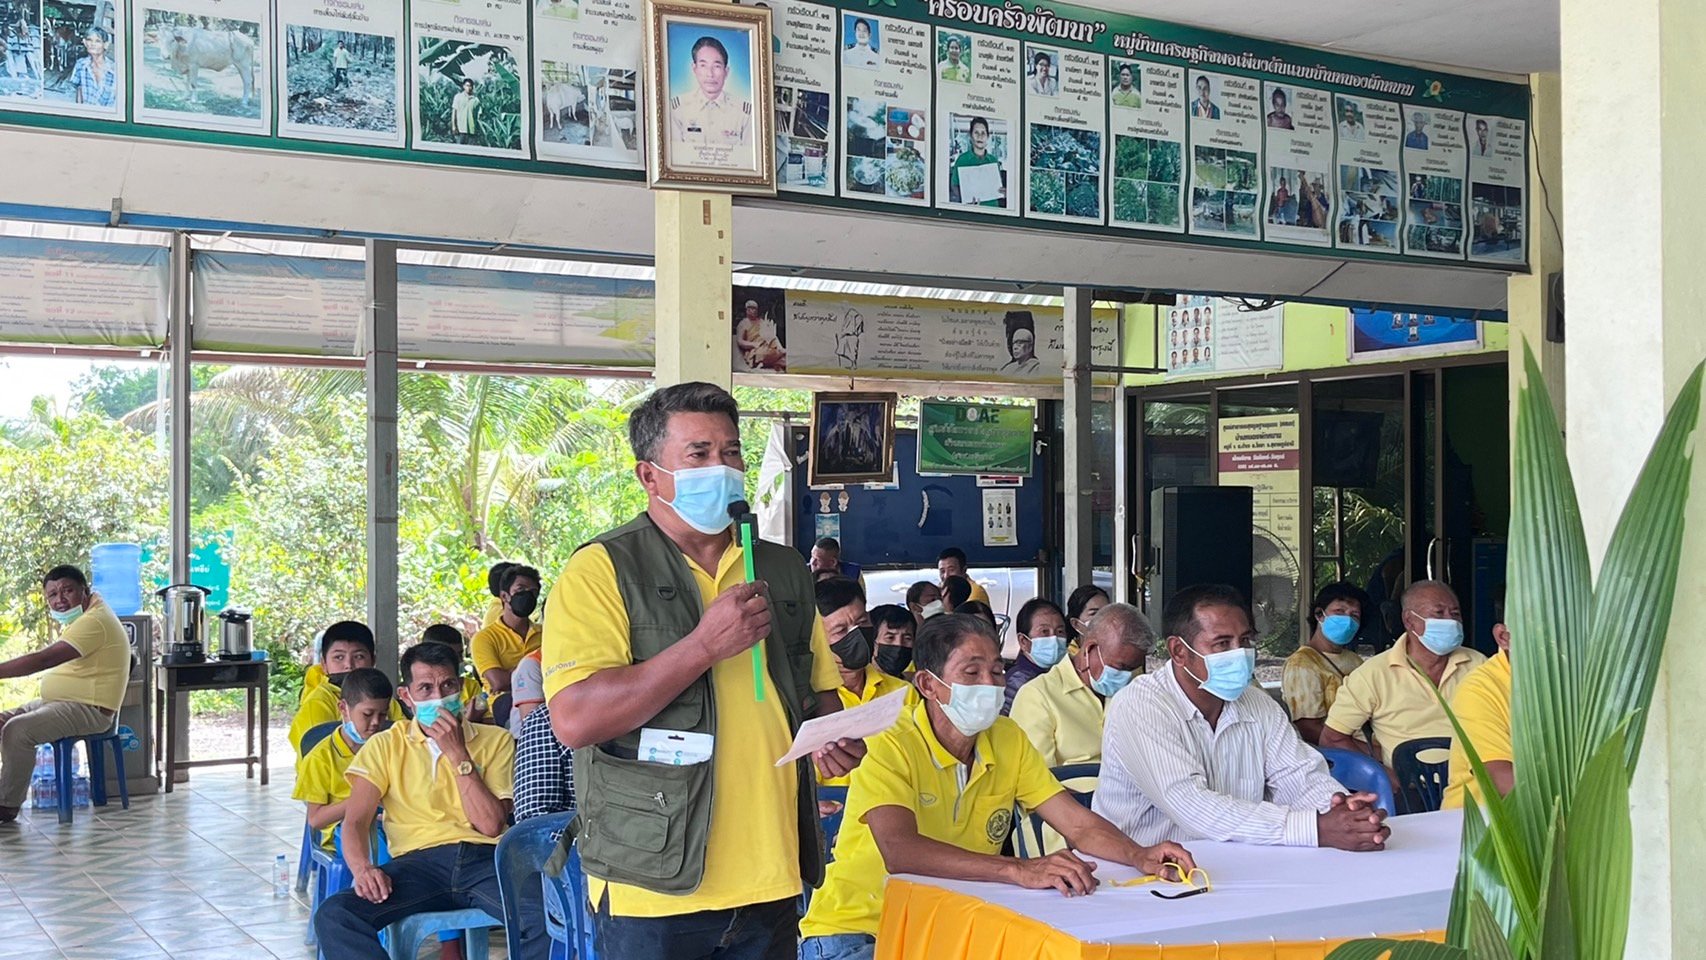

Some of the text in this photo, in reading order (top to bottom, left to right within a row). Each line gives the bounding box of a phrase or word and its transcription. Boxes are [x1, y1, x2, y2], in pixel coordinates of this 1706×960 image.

[787, 6, 819, 18] ครัวเรือนที่
[885, 23, 914, 35] ครัวเรือนที่
